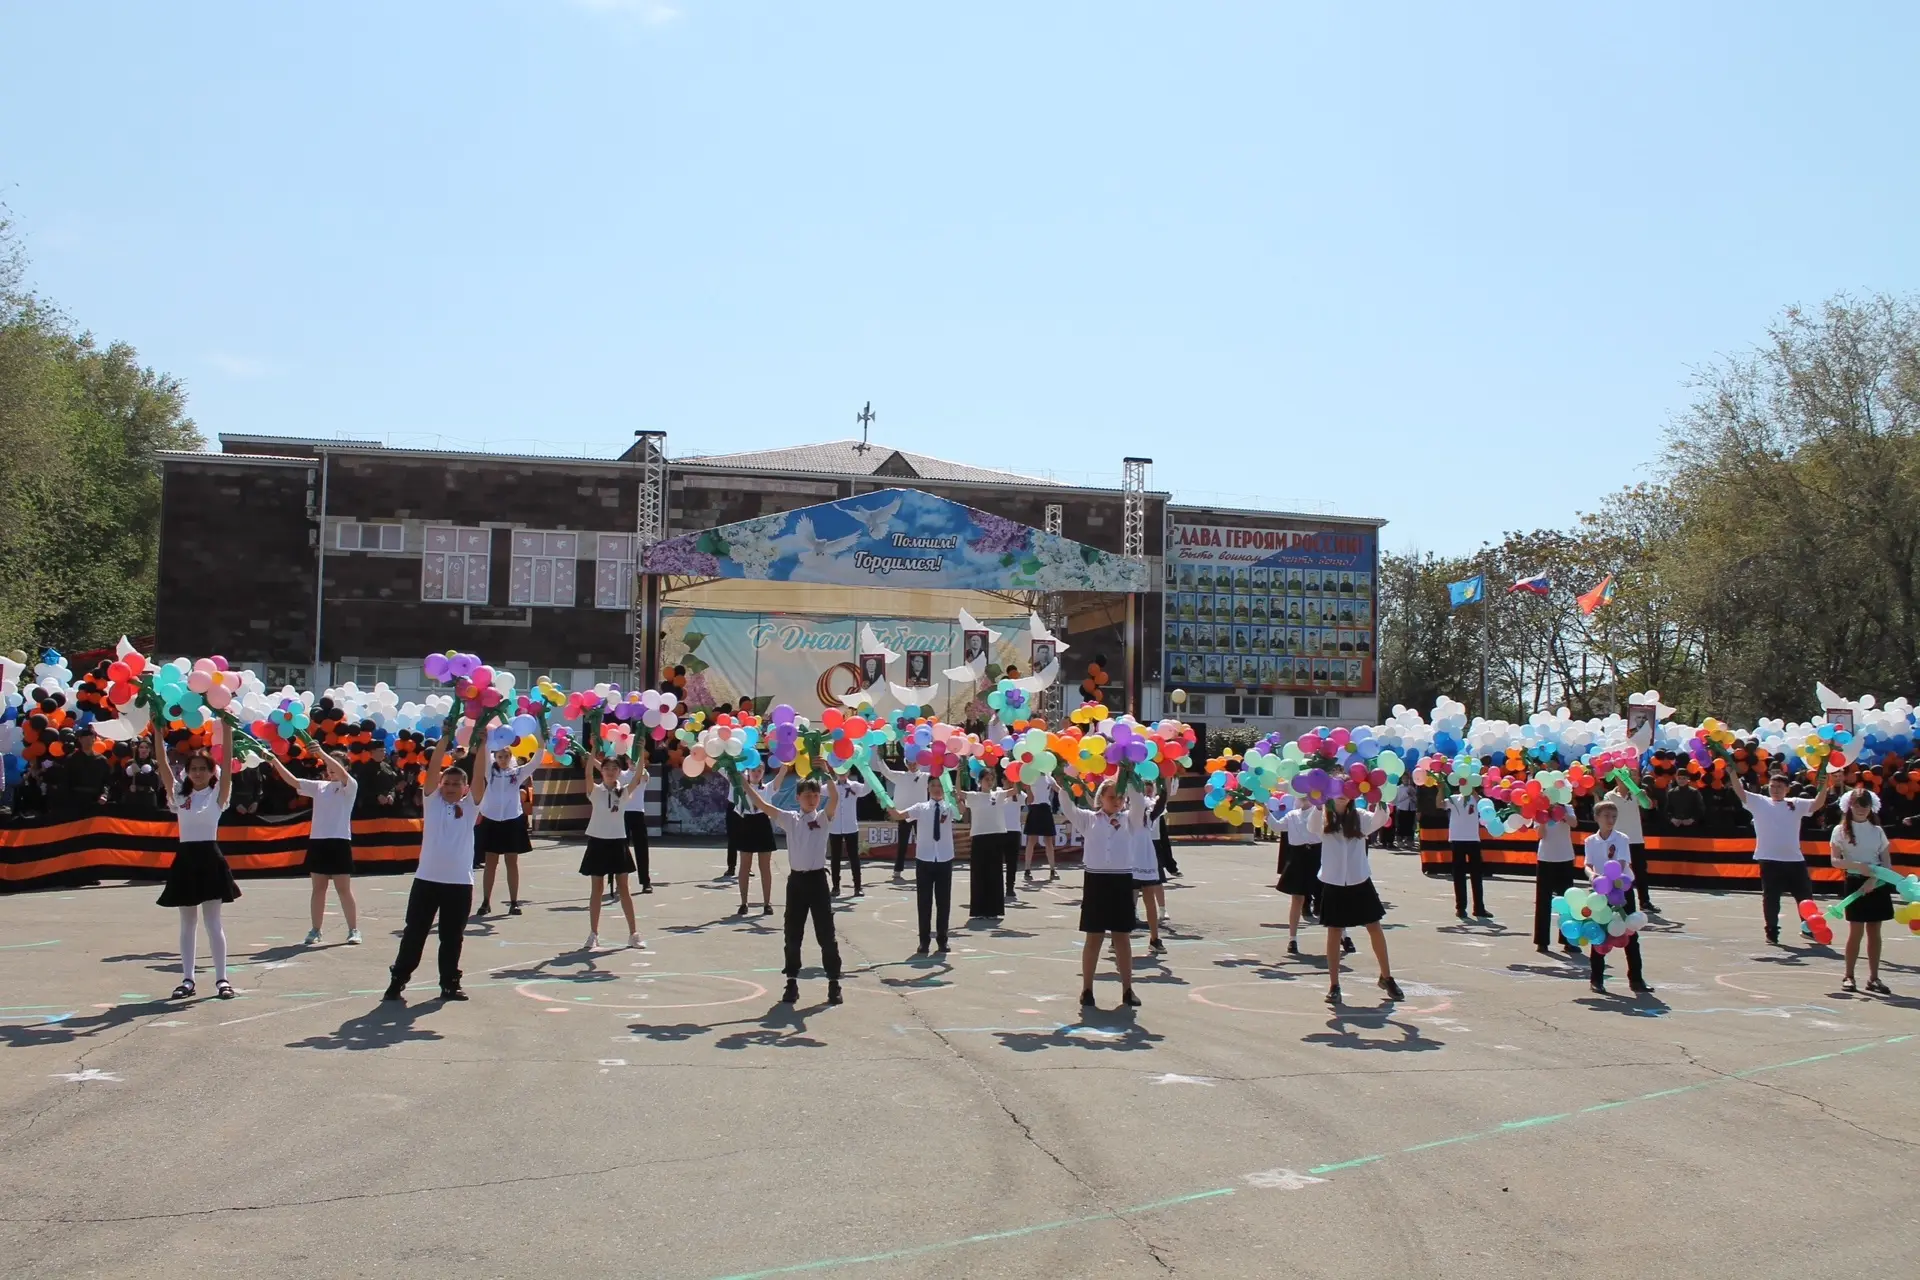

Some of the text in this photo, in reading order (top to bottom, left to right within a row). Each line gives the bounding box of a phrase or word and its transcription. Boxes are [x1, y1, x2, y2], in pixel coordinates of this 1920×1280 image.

[892, 533, 957, 549] Помним!
[1226, 529, 1288, 550] ГЕРОЯМ
[855, 551, 943, 574] Гордимся!
[1178, 548, 1214, 560] Быть
[748, 623, 776, 650] С
